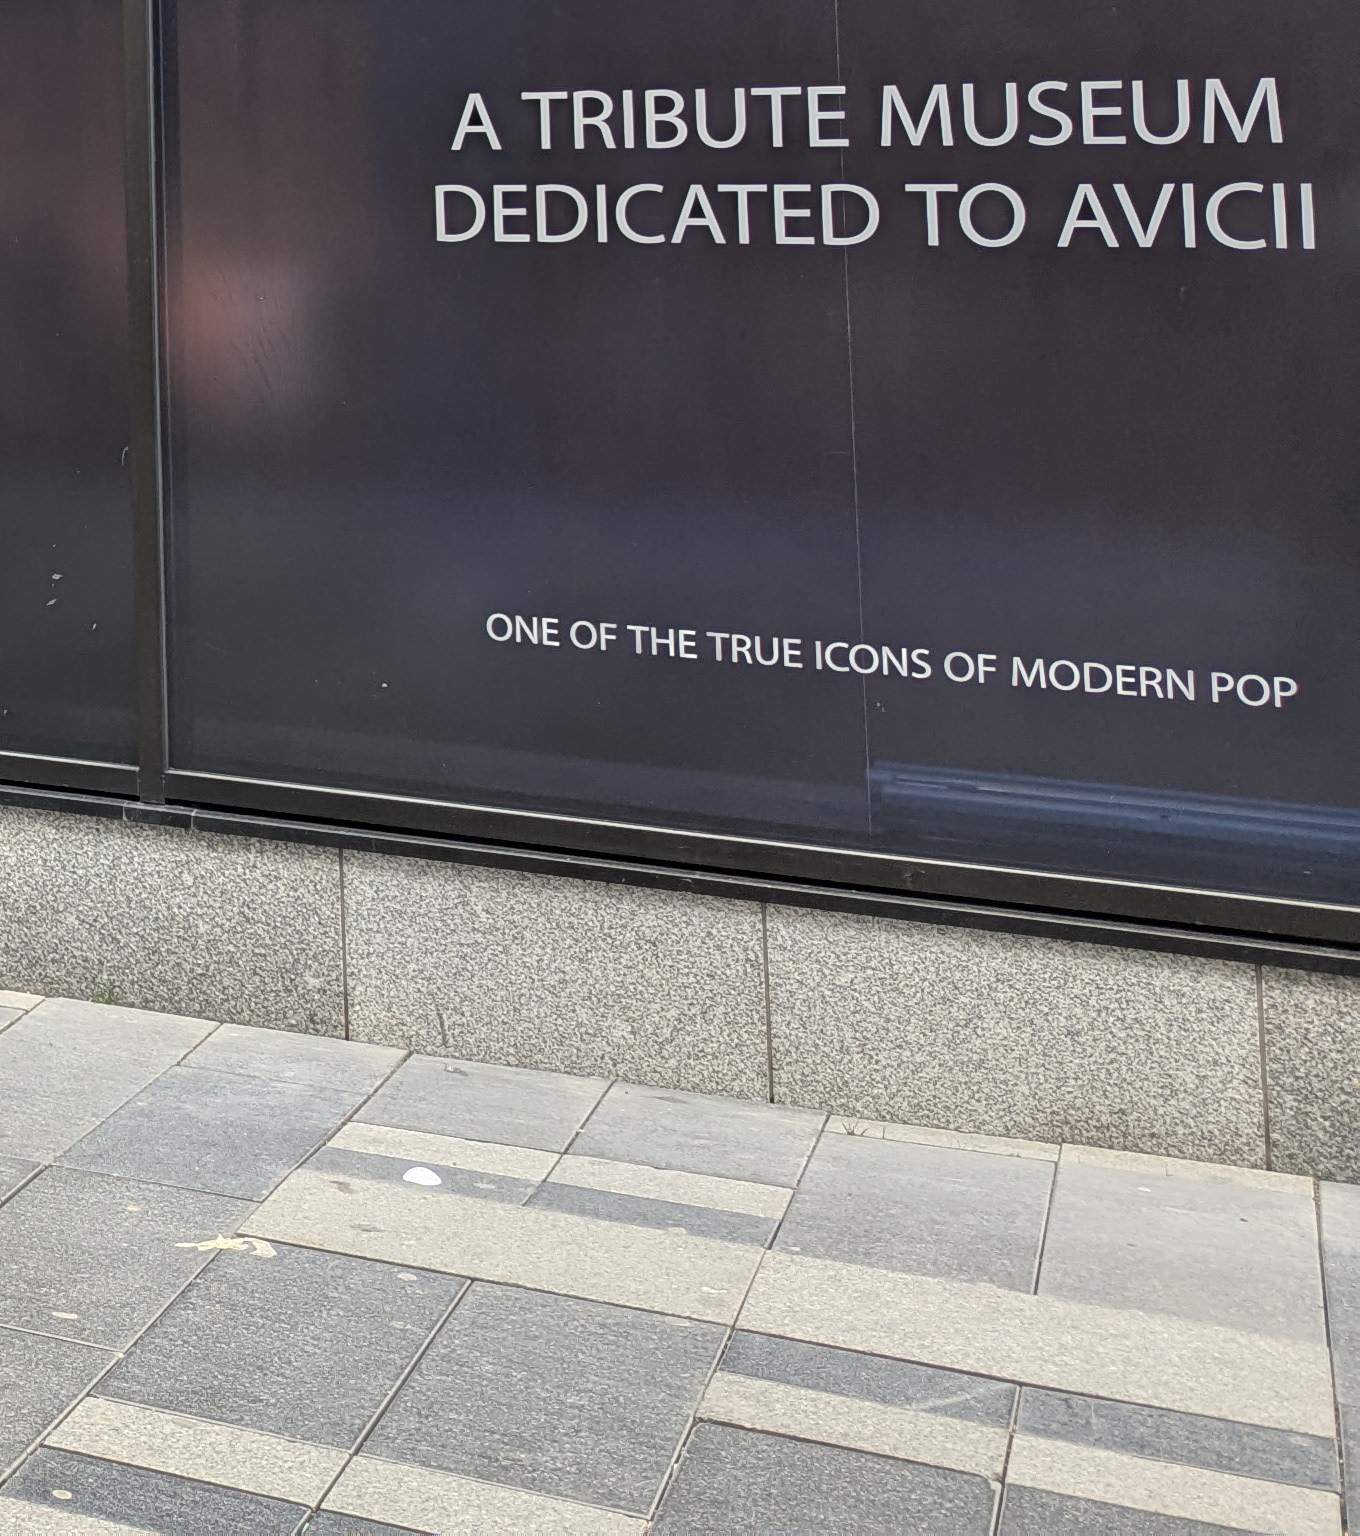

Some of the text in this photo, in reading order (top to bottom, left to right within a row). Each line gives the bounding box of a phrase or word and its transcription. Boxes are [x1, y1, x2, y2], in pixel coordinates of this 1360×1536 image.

[451, 77, 1284, 150] A TRIBUTE MUSEUM
[434, 182, 1316, 250] DEDICATED TO AVICII
[485, 612, 1299, 710] ONE OF THE TRUE ICONS OF MODERN POP
